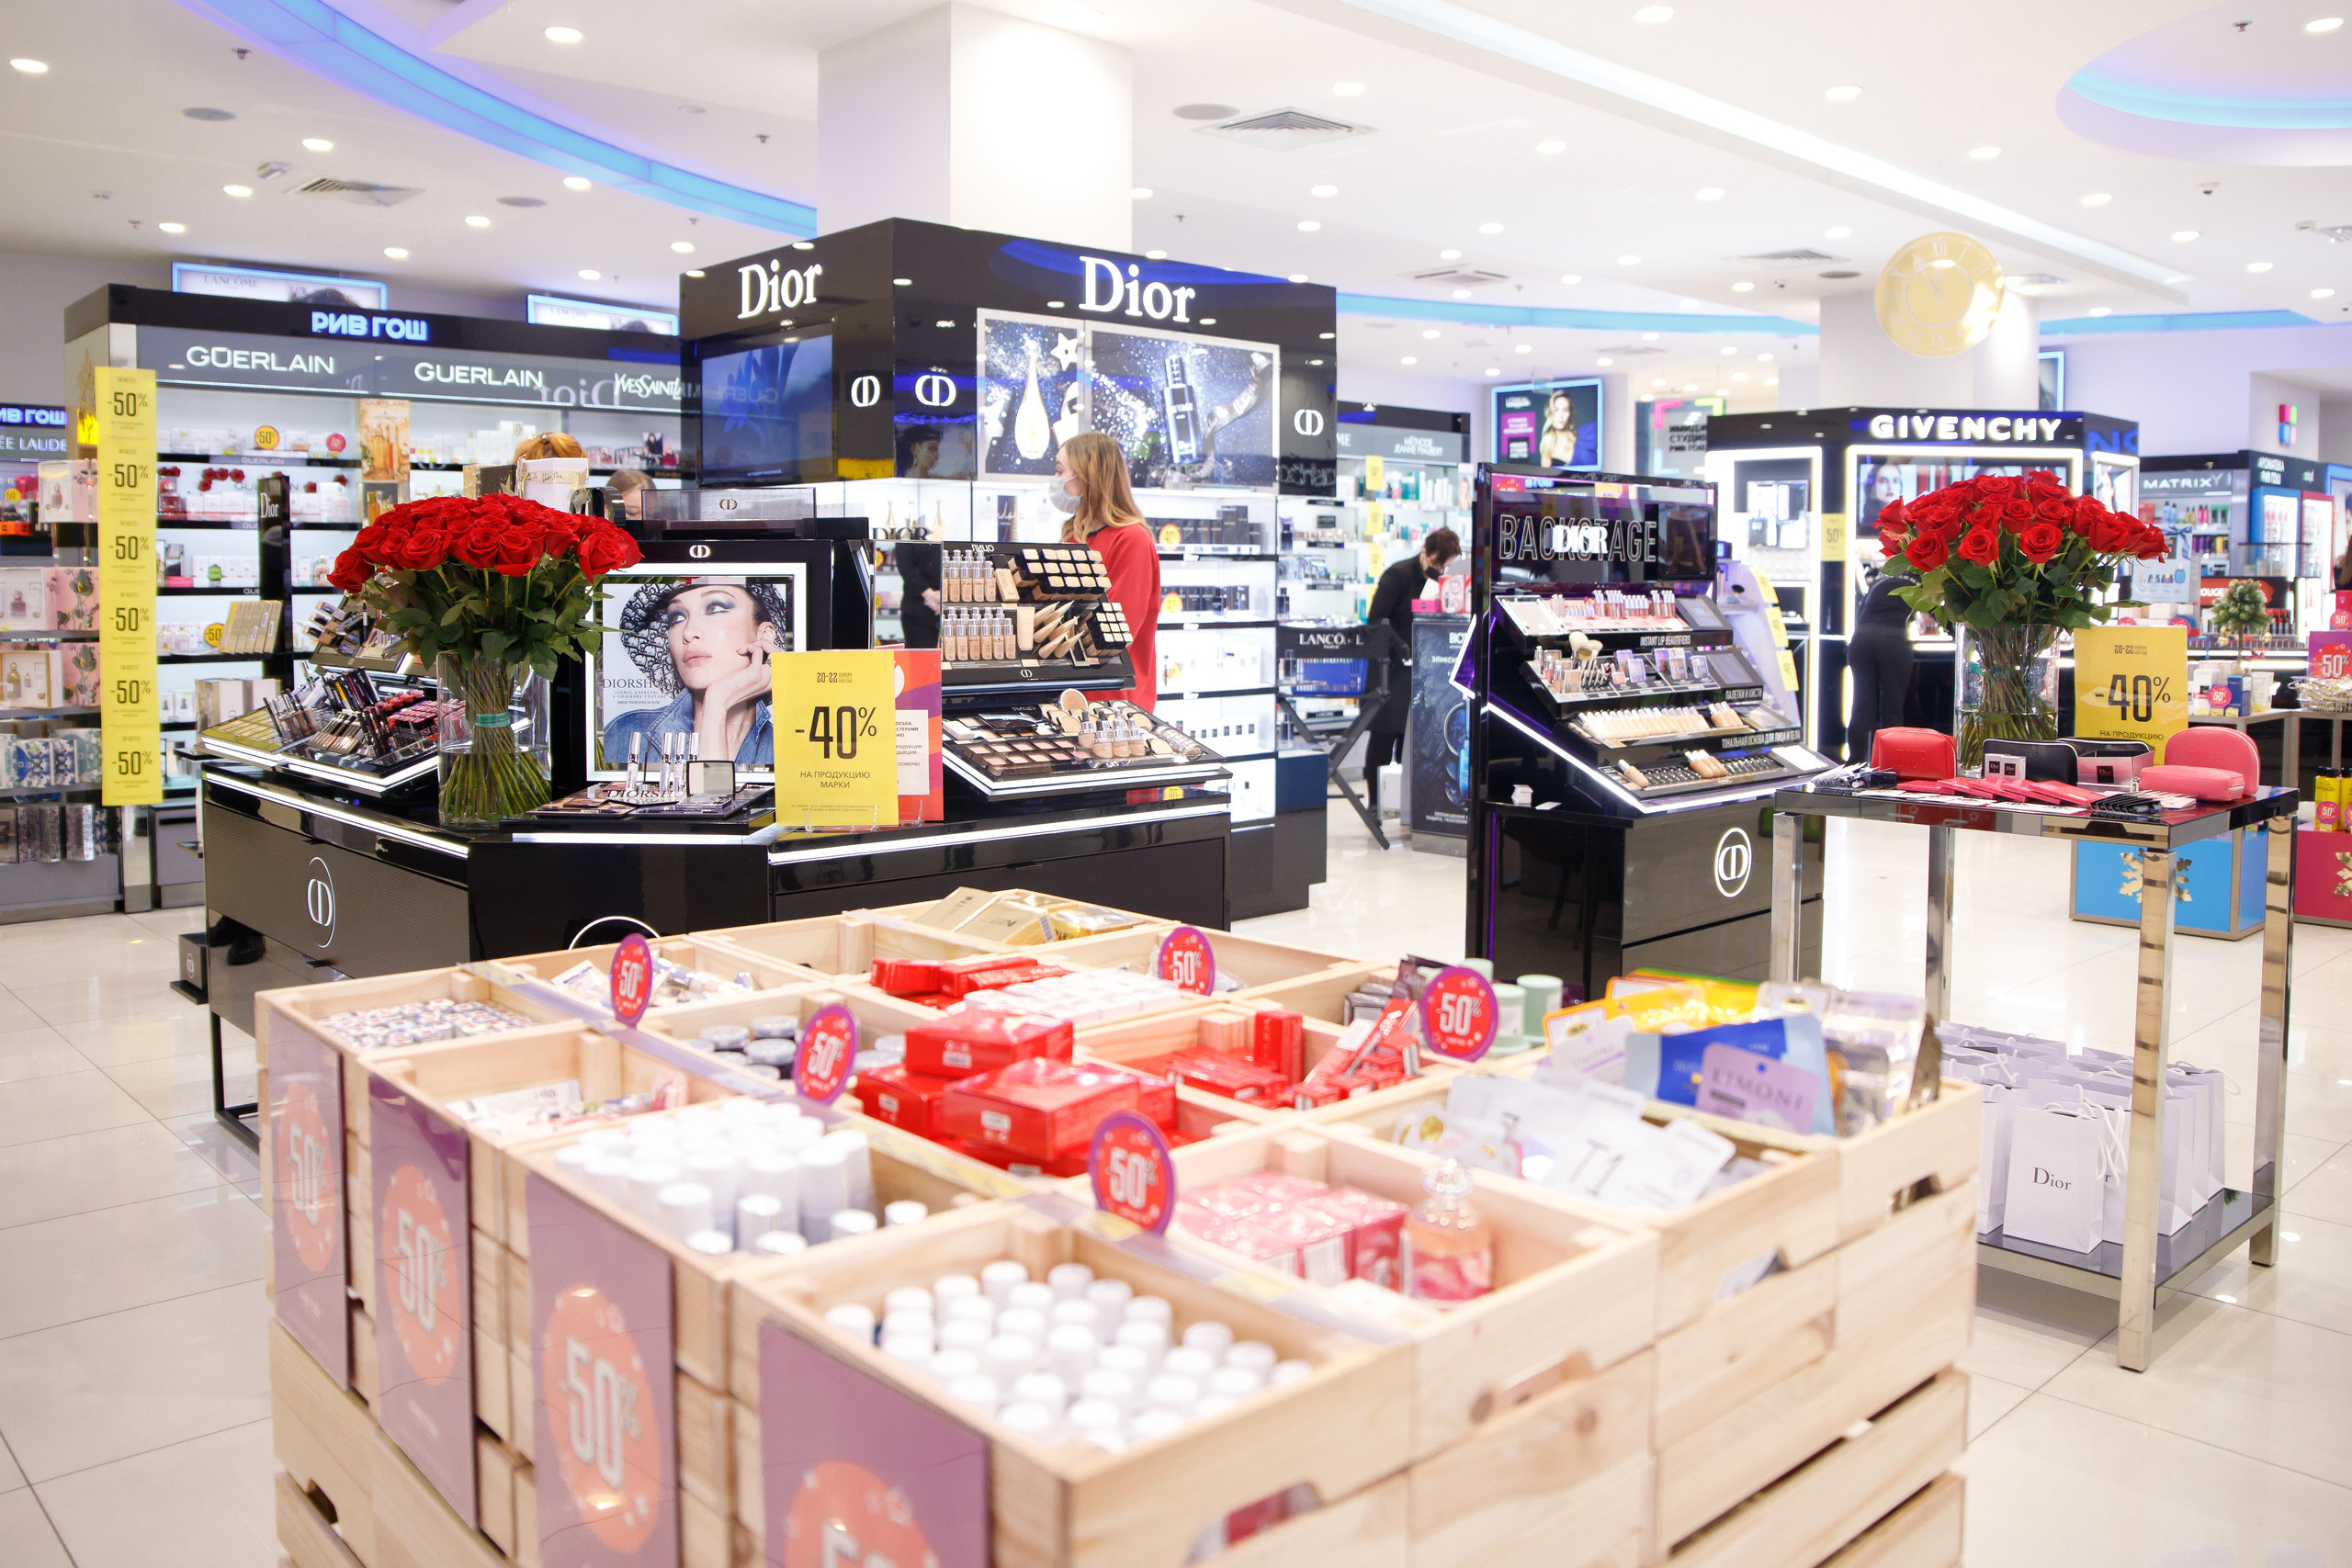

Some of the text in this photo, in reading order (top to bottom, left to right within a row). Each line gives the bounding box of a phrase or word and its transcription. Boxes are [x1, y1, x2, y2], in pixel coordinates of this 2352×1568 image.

[737, 258, 823, 320] Dior
[1079, 255, 1196, 323] Dior
[311, 310, 428, 341] РИВ ГОШ
[186, 344, 336, 376] GUERLAIN
[413, 361, 544, 389] GUERLAIN
[0, 407, 68, 425] ИВ ГОШ
[107, 392, 148, 417] -50%
[1871, 415, 2063, 441] GIVENCHY
[19, 437, 68, 452] LAUDE
[107, 464, 149, 488] -50%
[2143, 476, 2212, 490] MATRIX
[260, 492, 279, 519] Dior
[108, 536, 149, 559] -50%
[971, 544, 994, 553] ЛИЦО
[109, 607, 150, 631] -50%
[206, 628, 222, 641] -50
[1640, 636, 1657, 646] INSTANT
[1666, 635, 1691, 646] BEAUTIFIERS
[603, 678, 677, 689] DIORSHOW
[817, 672, 838, 683] 20-22
[110, 680, 151, 704] -50%
[2096, 674, 2171, 722] -40%
[795, 705, 877, 760] -40%
[2112, 730, 2165, 740] ПРОДУКЦИЮ
[111, 751, 153, 775] -50%
[814, 771, 871, 780] ПРОДУКЦИЮ
[820, 781, 850, 789] МАРКИ
[607, 790, 686, 798] DIORSHO
[2031, 1166, 2072, 1191] Dior
